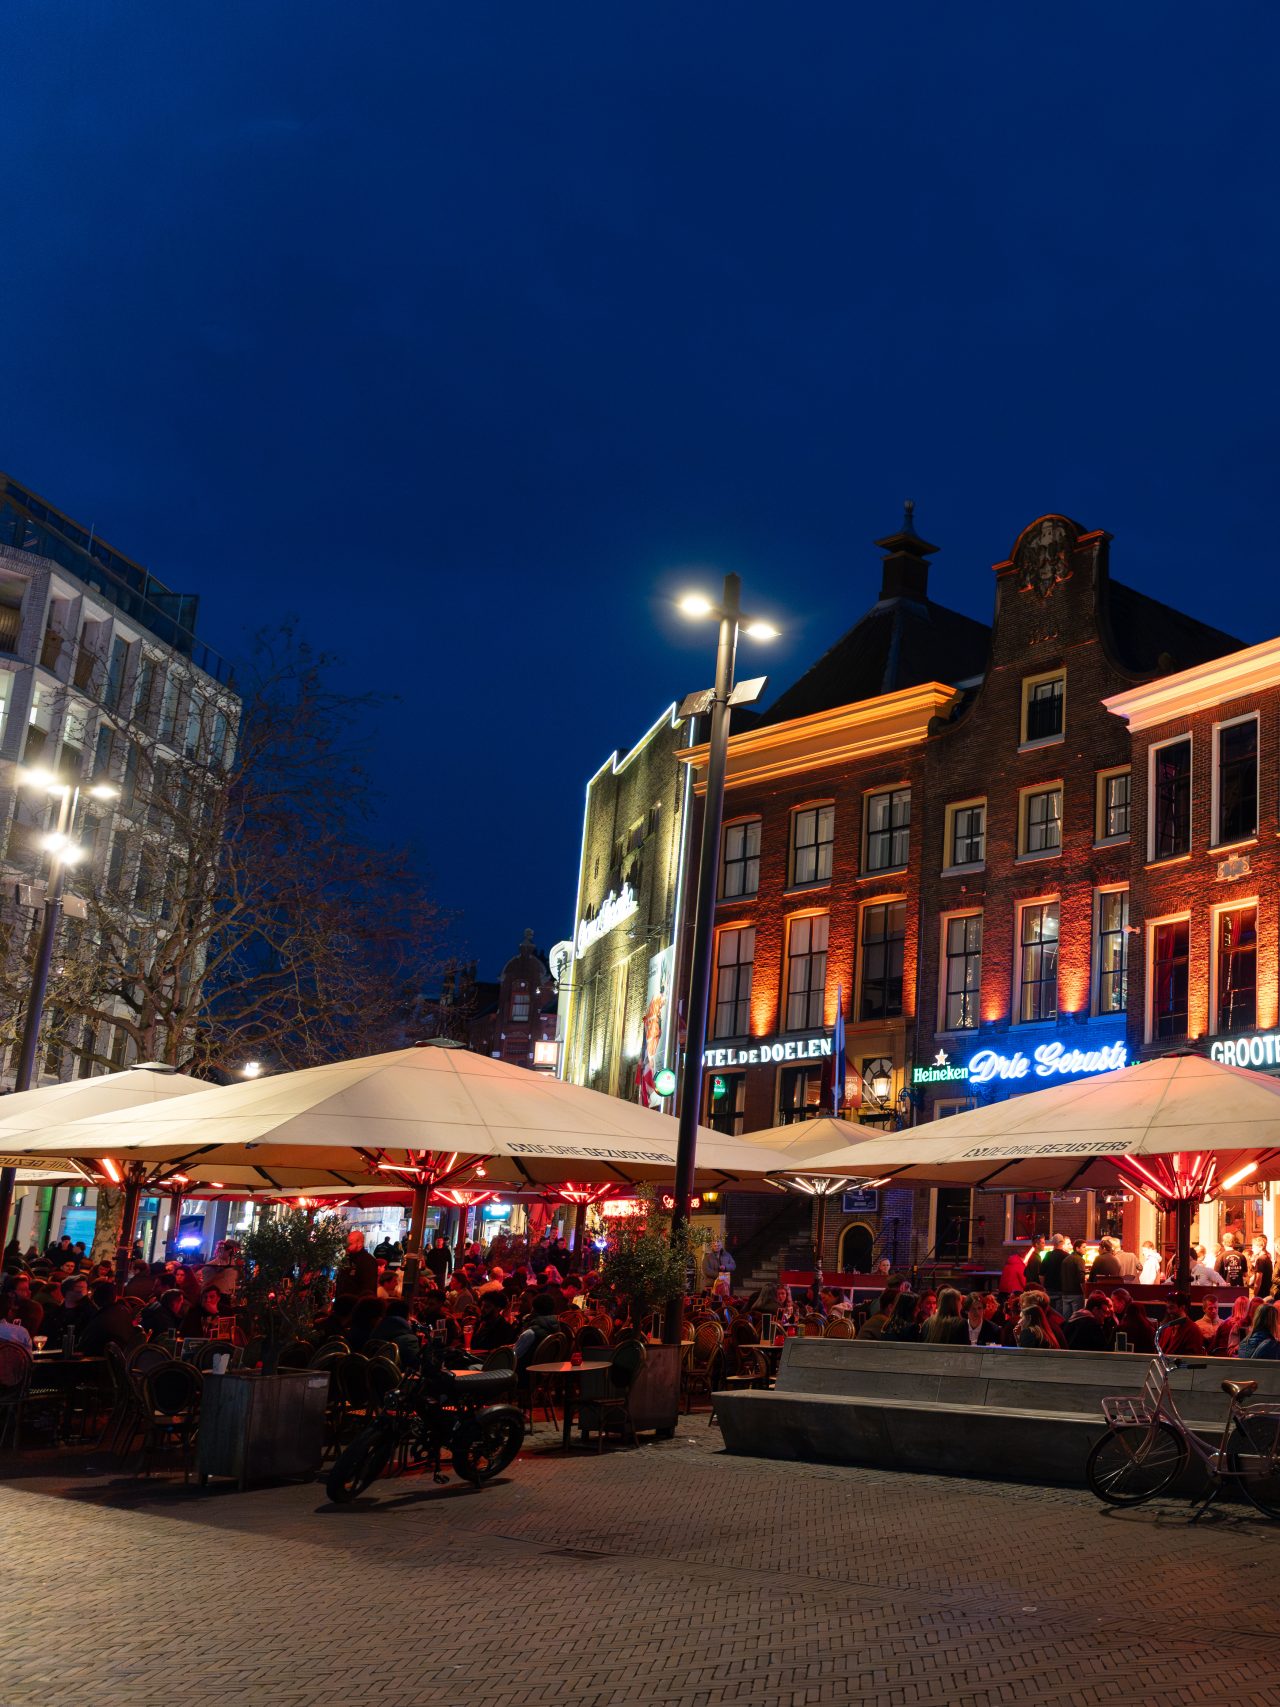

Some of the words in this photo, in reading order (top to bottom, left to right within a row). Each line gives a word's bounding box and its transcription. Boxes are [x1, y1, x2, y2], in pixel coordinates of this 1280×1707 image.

[684, 1048, 737, 1067] TEL
[739, 1050, 758, 1064] DE
[760, 1038, 832, 1063] DOELEN
[913, 1065, 969, 1082] Heineken
[969, 1050, 1031, 1083] Drie
[527, 1143, 553, 1154] DE
[548, 1145, 586, 1156] DRIE
[582, 1147, 676, 1163] GEZUSTERS
[982, 1146, 1007, 1157] DE
[1002, 1144, 1041, 1156] DRIE
[1035, 1140, 1132, 1155] GEZUSTERS
